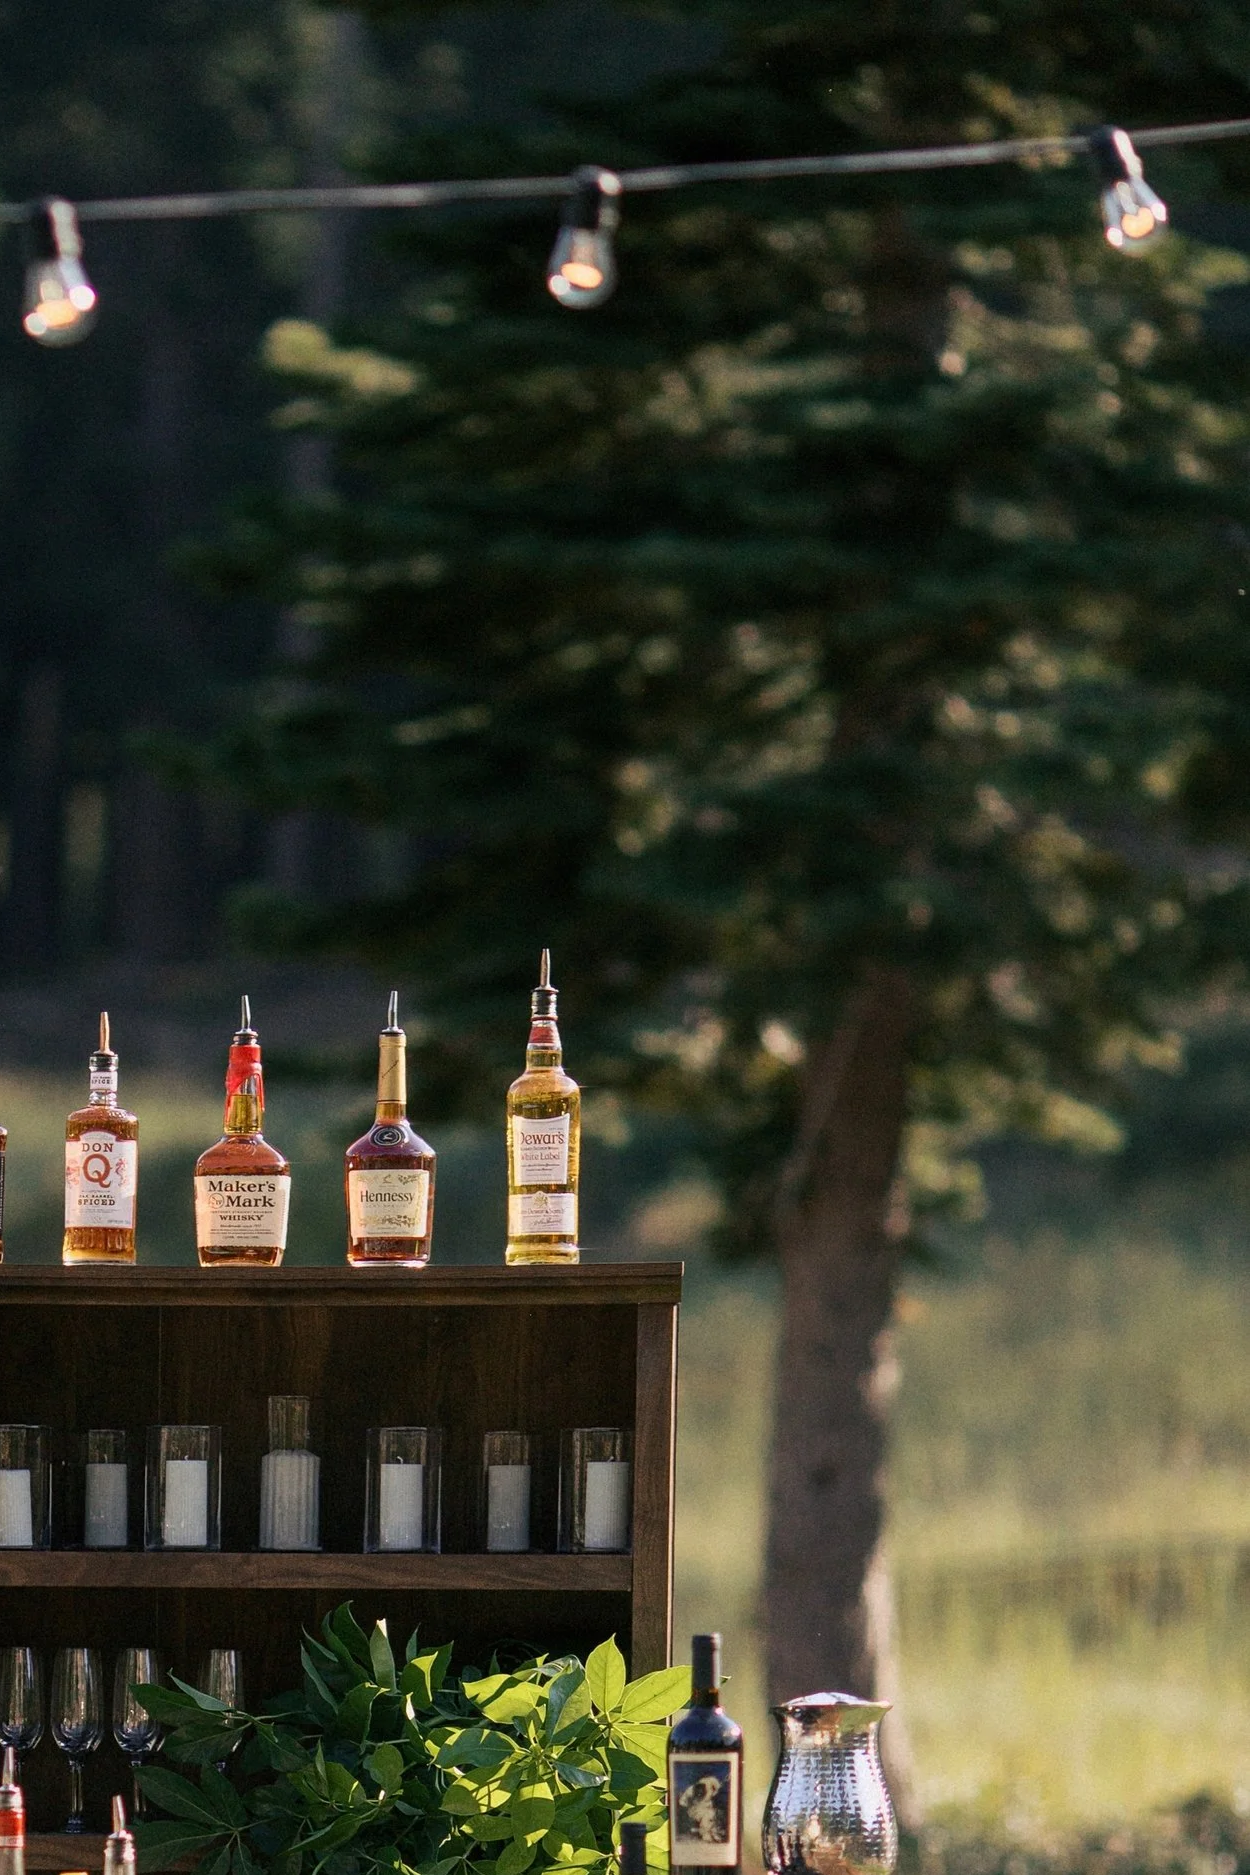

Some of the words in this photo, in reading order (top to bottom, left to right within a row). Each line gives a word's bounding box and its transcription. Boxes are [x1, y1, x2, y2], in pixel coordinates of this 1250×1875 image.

[81, 1142, 114, 1153] DON
[82, 1153, 112, 1189] Q
[208, 1180, 276, 1193] Maker's
[224, 1194, 275, 1208] Mark
[360, 1190, 416, 1205] Hennessy
